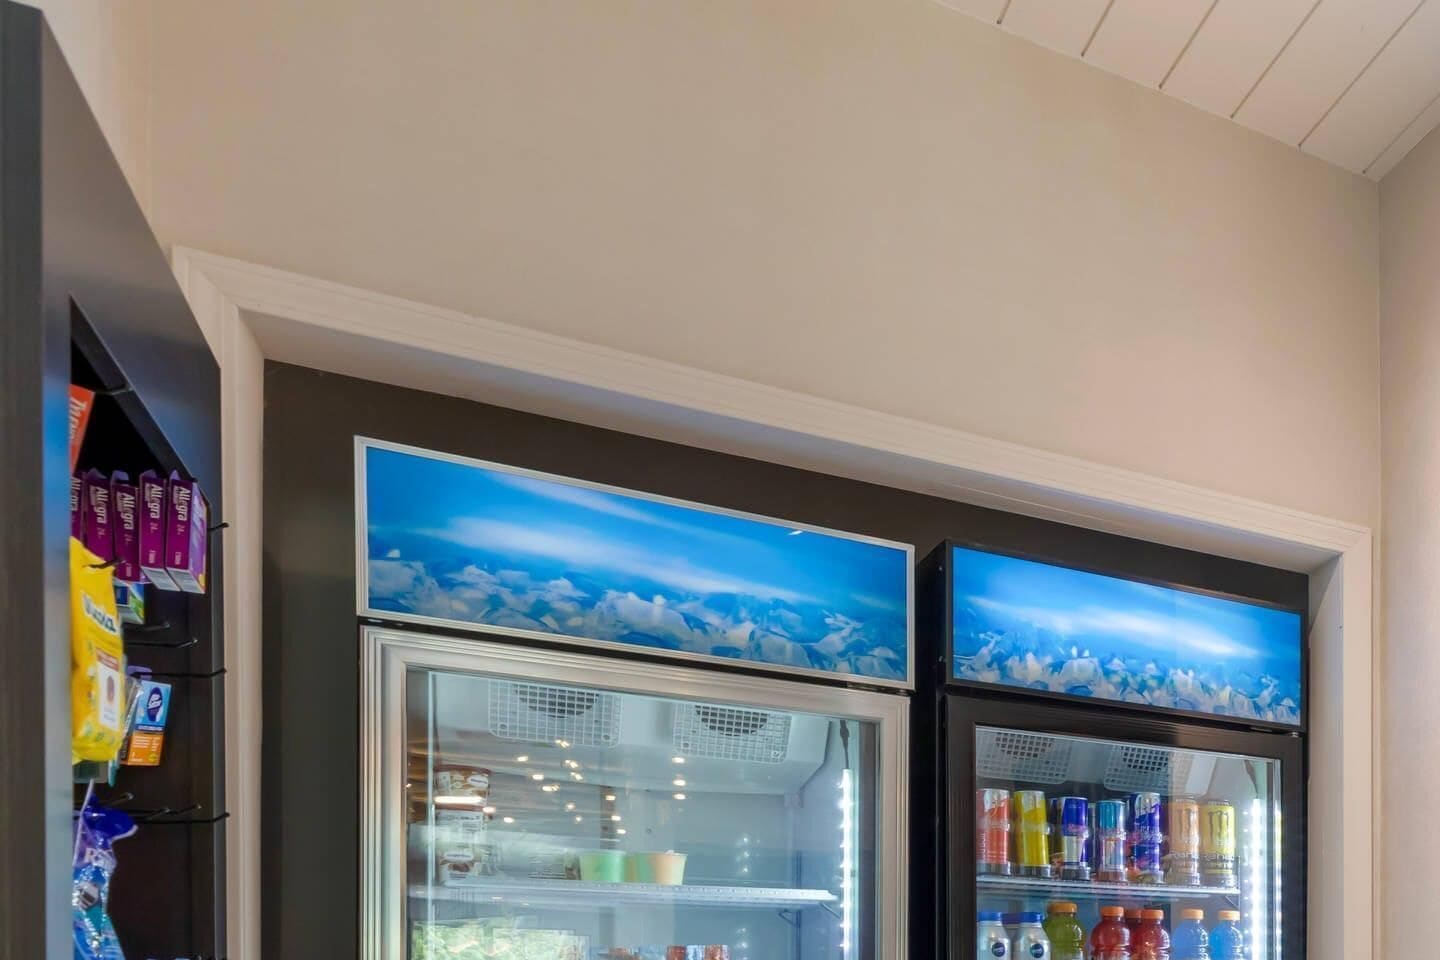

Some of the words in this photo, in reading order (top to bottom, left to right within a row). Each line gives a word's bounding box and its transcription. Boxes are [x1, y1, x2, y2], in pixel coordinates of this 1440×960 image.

[94, 486, 108, 524] Allegra
[121, 492, 135, 530] Allegra
[148, 484, 162, 519] Allegra
[176, 486, 191, 521] Allegra
